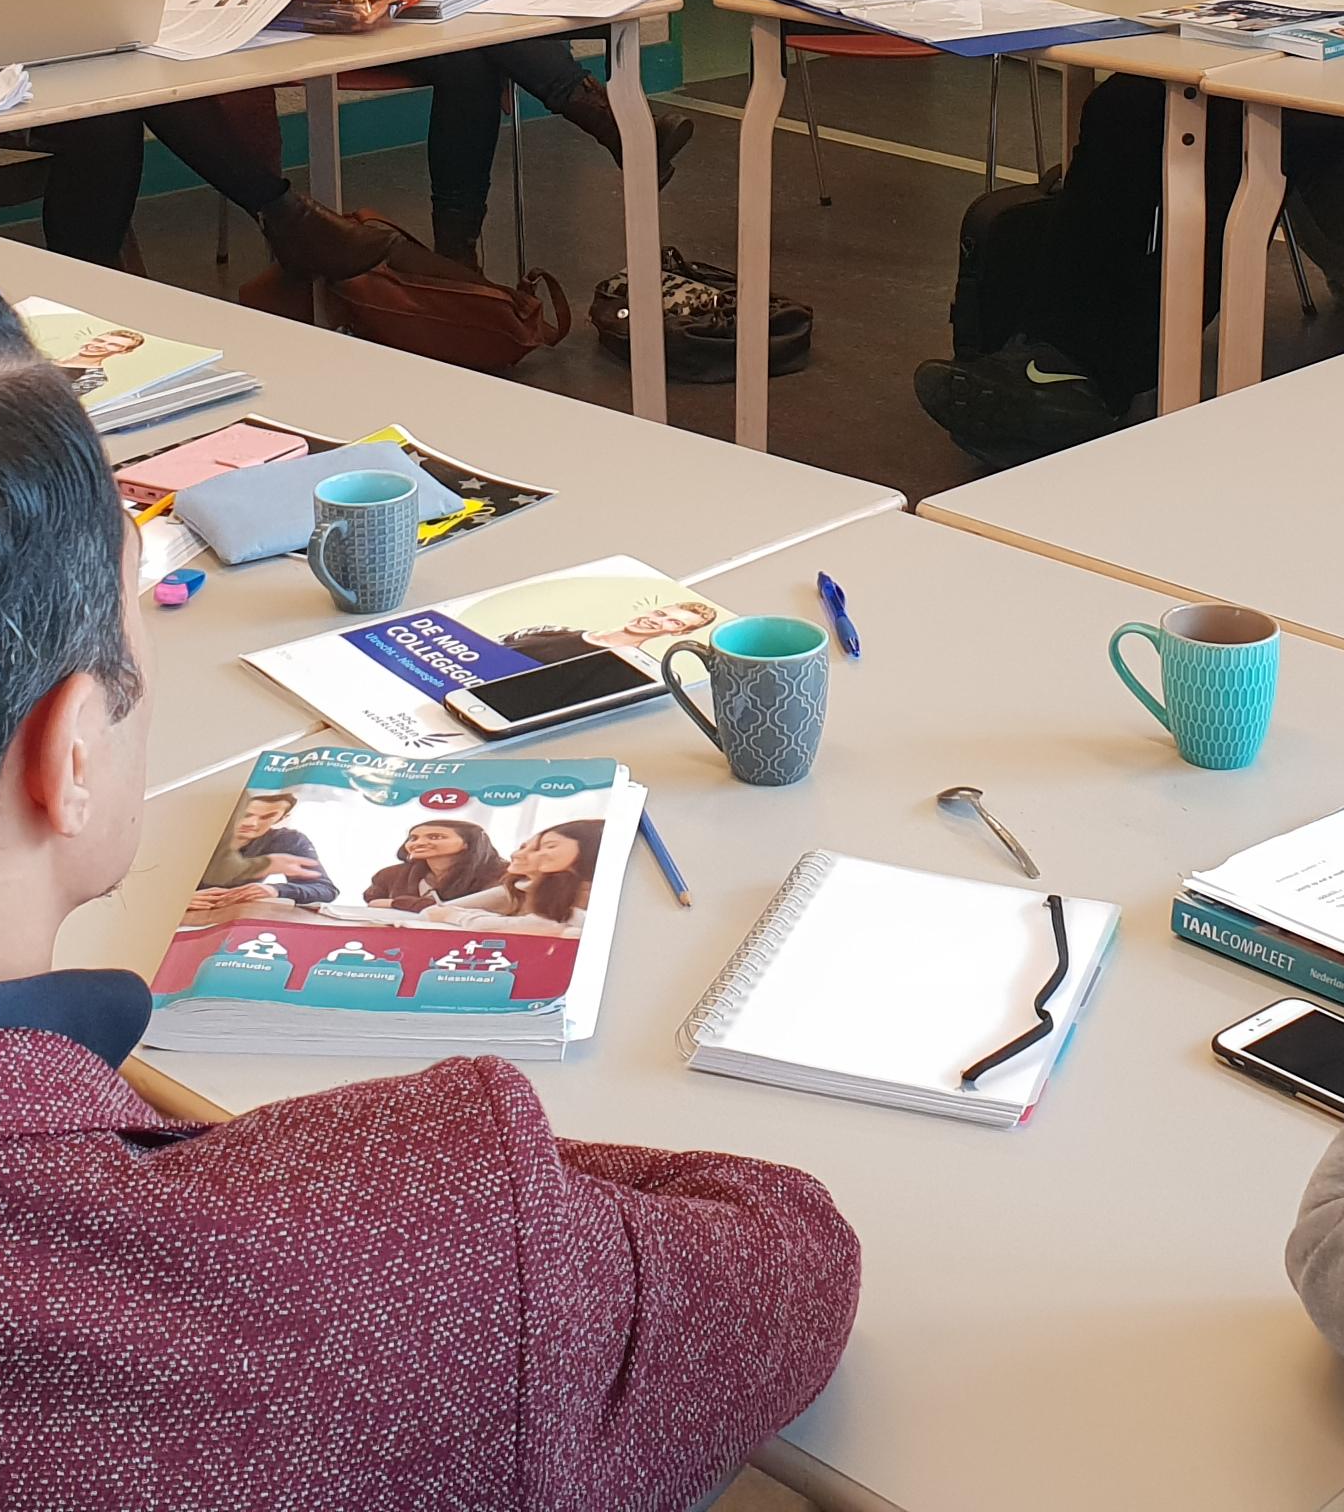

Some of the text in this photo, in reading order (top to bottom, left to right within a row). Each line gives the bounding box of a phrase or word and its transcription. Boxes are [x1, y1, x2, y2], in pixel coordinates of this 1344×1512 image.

[365, 633, 396, 657] Utrecht
[411, 618, 481, 663] DE MBO
[387, 625, 487, 688] COLLEGEGID
[269, 750, 465, 774] TAALCOMPLEET
[540, 781, 575, 791] ONA
[428, 793, 458, 804] A2
[483, 791, 520, 800] KNM
[1181, 912, 1296, 972] TAALCOMPLEET
[215, 961, 272, 971] zelfstudie
[437, 974, 494, 983] klassikaal
